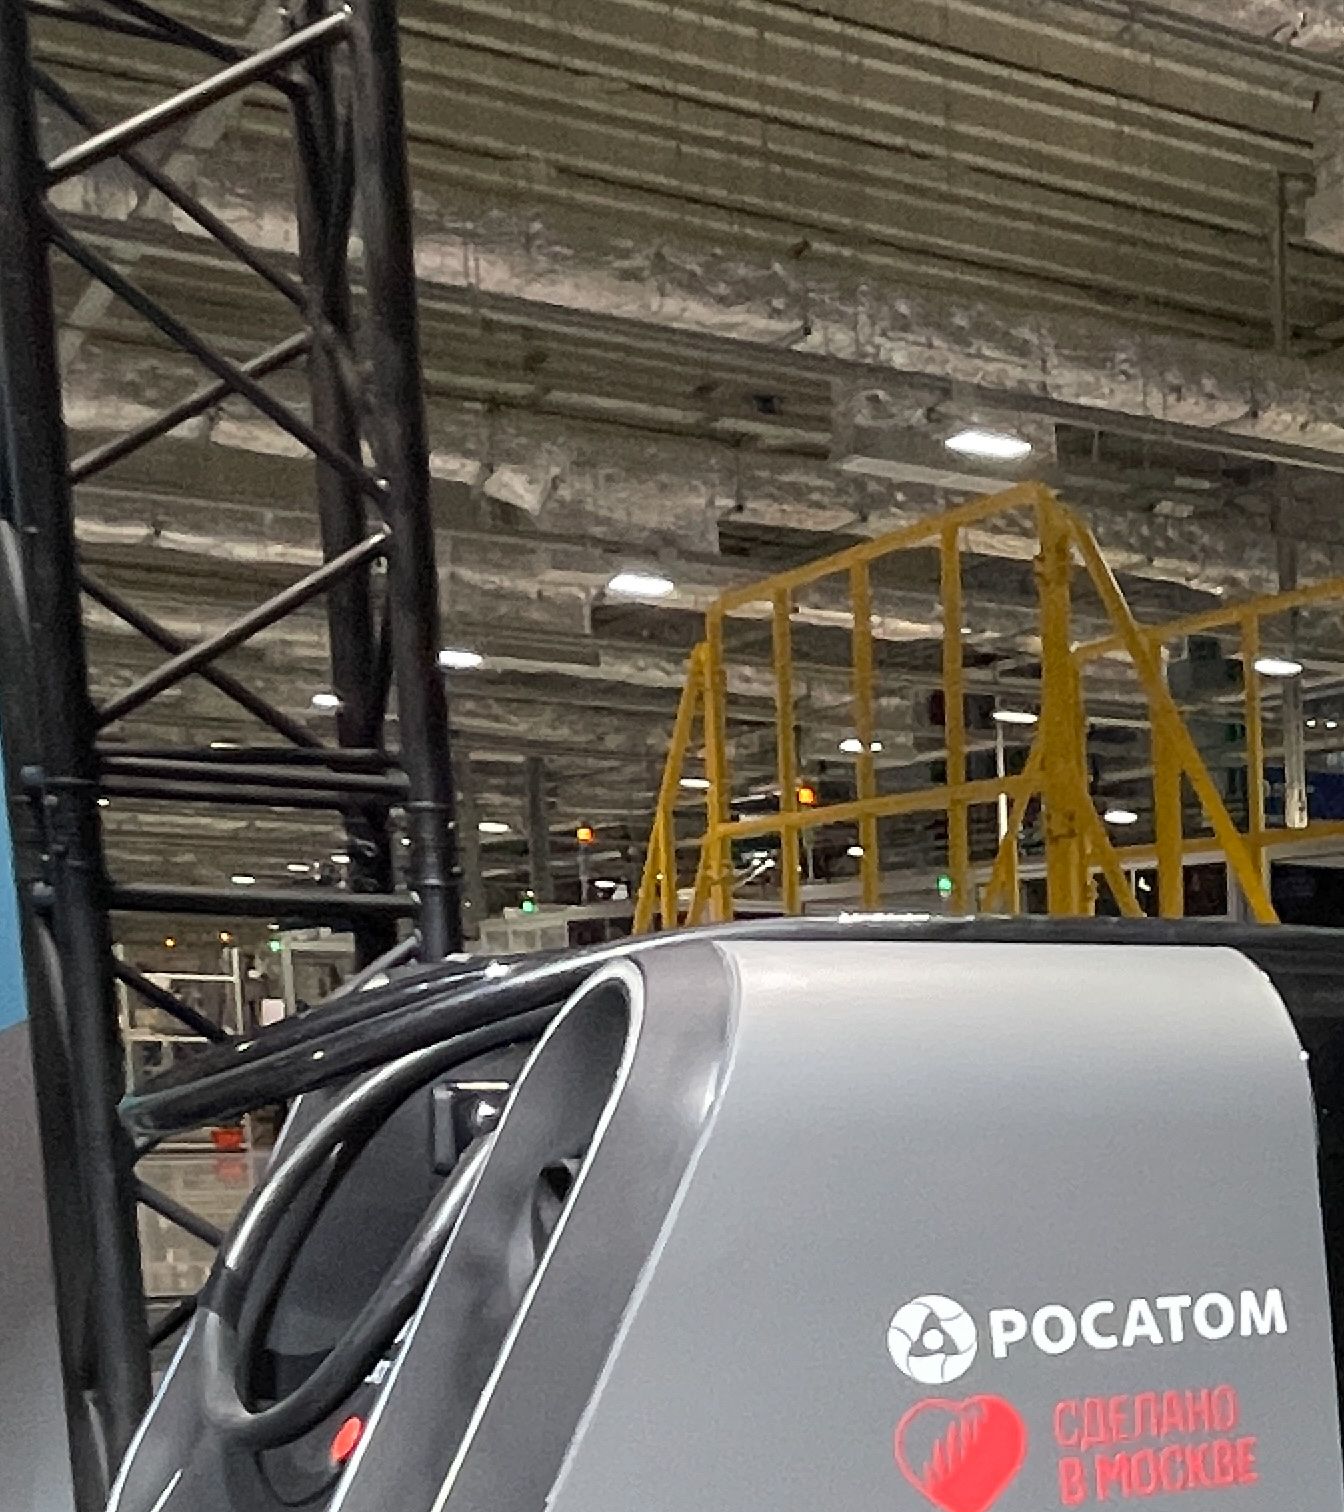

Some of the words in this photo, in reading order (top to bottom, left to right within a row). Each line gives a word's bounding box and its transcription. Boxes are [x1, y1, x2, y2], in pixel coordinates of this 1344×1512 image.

[989, 1287, 1288, 1359] РОСАТОМ
[1053, 1384, 1241, 1452] СДЕЛАНО
[1057, 1456, 1088, 1507] В
[1095, 1436, 1261, 1502] МОСКВЕ
